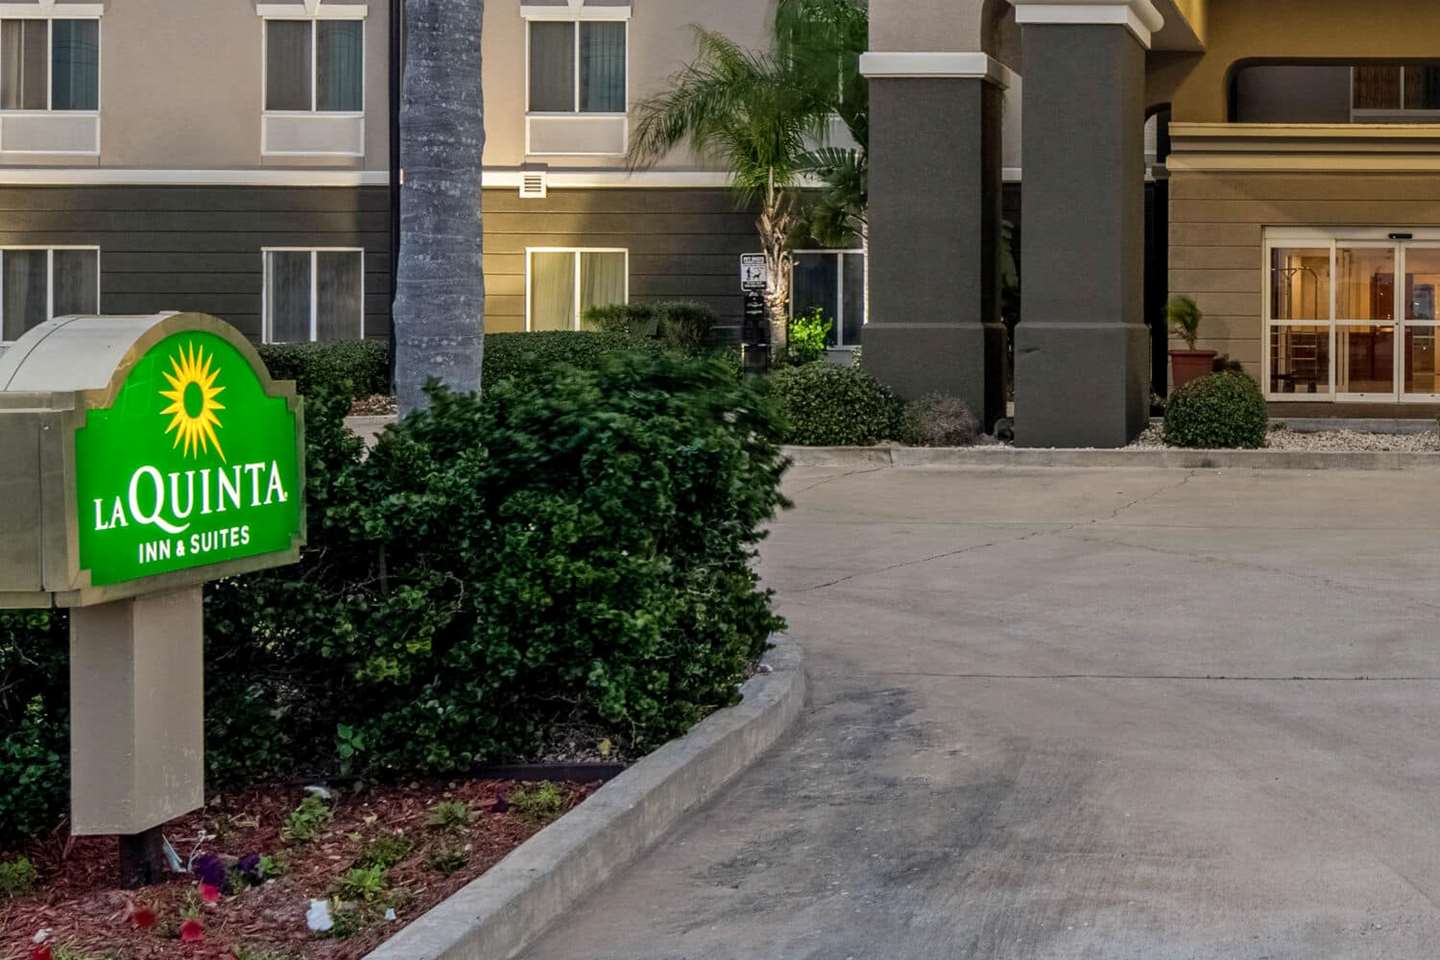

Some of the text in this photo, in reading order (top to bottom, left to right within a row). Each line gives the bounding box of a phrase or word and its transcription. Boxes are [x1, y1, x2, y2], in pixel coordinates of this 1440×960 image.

[93, 460, 287, 534] LA QUINTA
[139, 525, 250, 564] INN & SUITES
